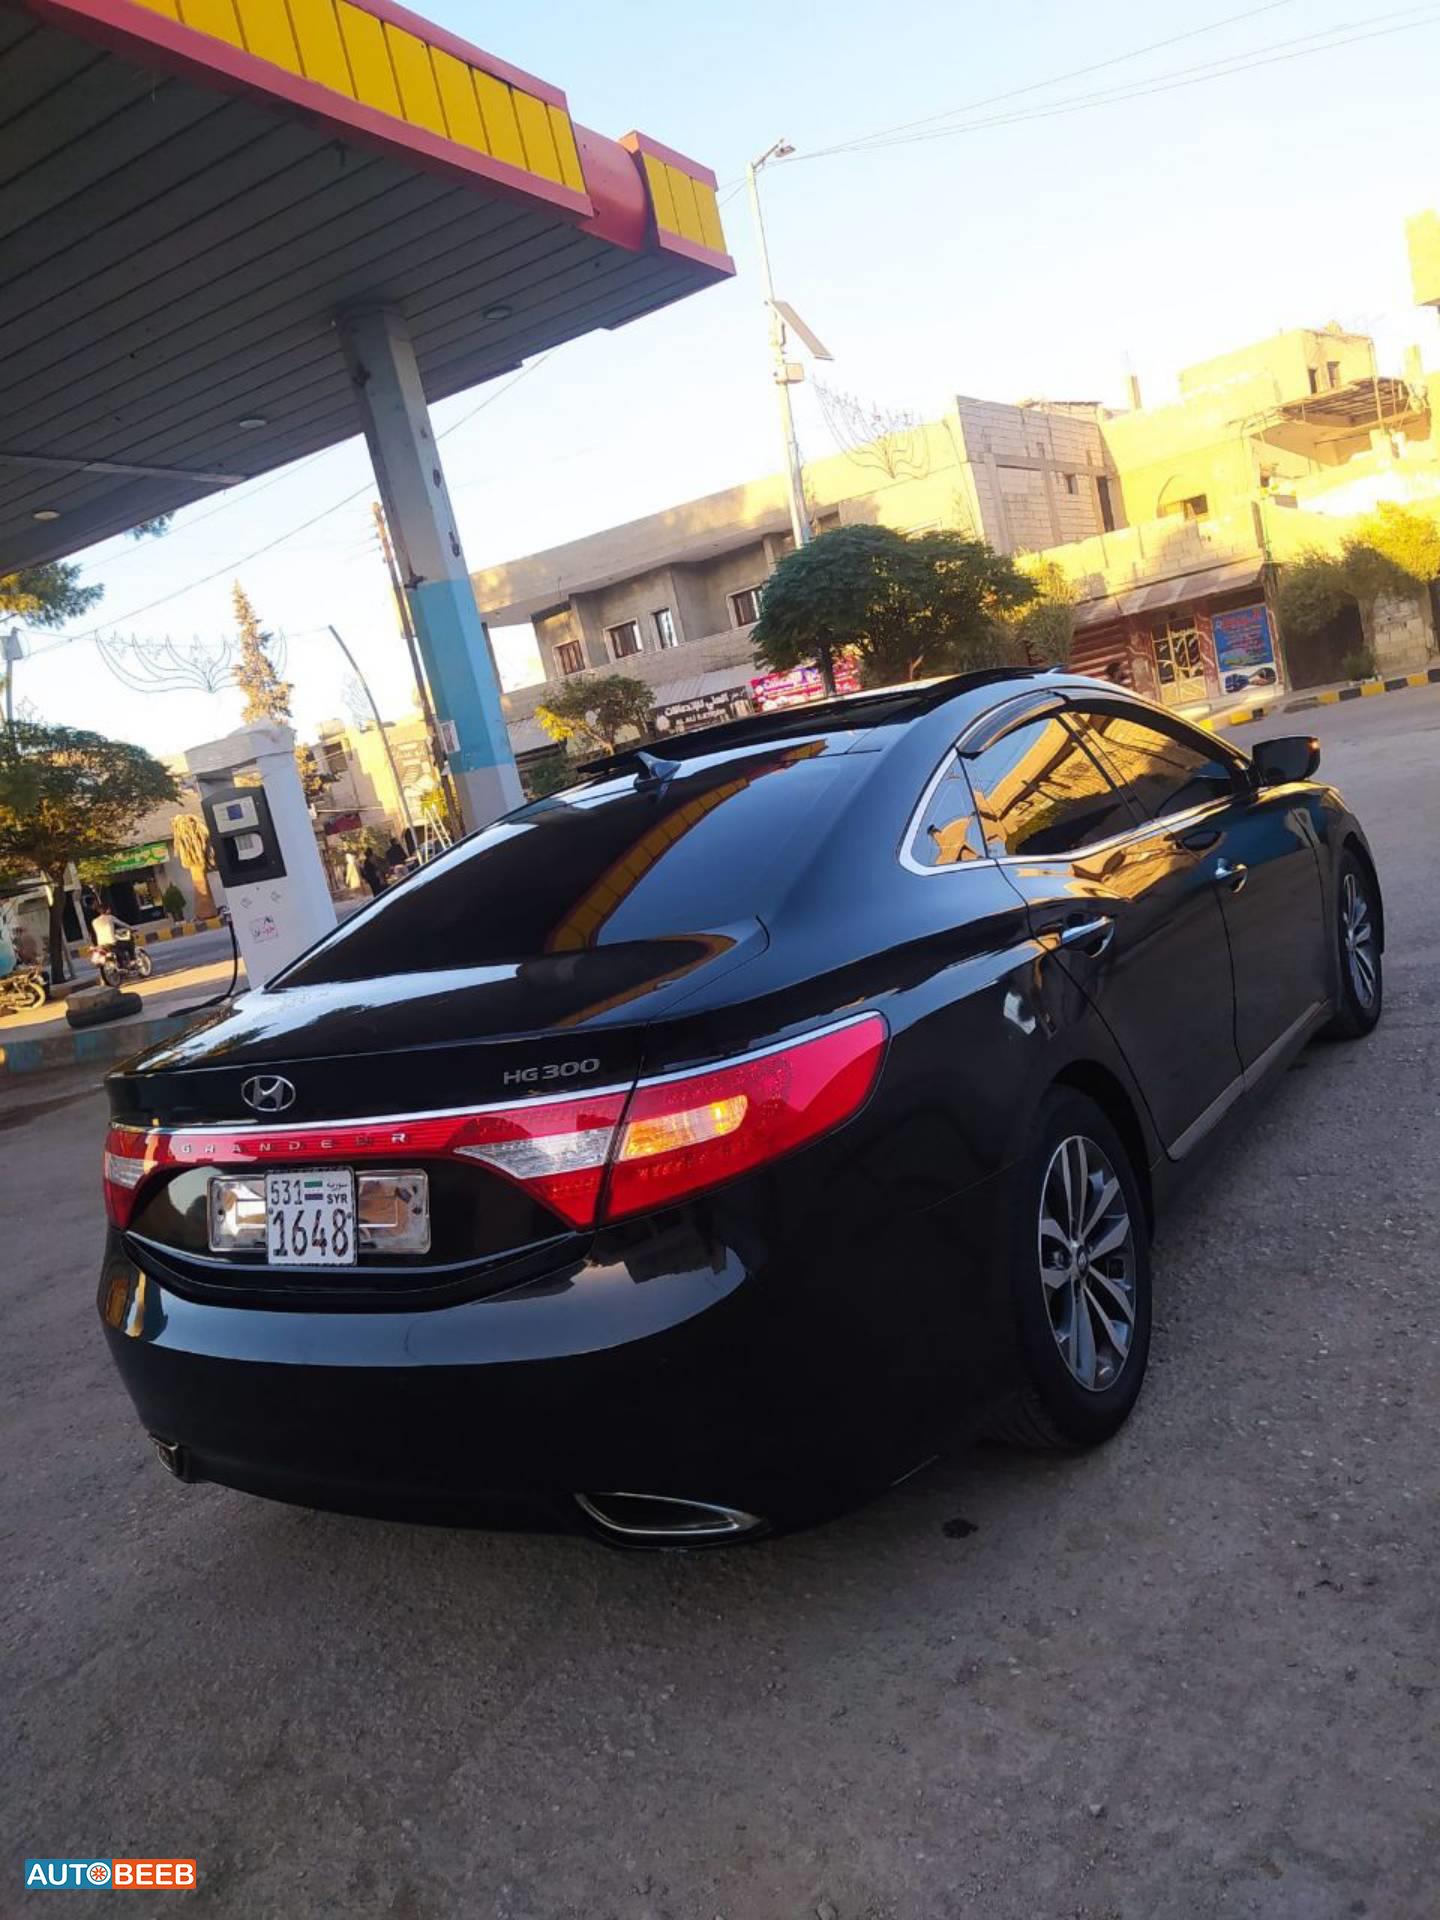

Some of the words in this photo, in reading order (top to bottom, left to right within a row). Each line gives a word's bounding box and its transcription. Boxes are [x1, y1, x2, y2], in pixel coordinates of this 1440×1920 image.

[270, 1179, 303, 1205] 531
[326, 1193, 348, 1204] SYR
[273, 1208, 349, 1257] 1648
